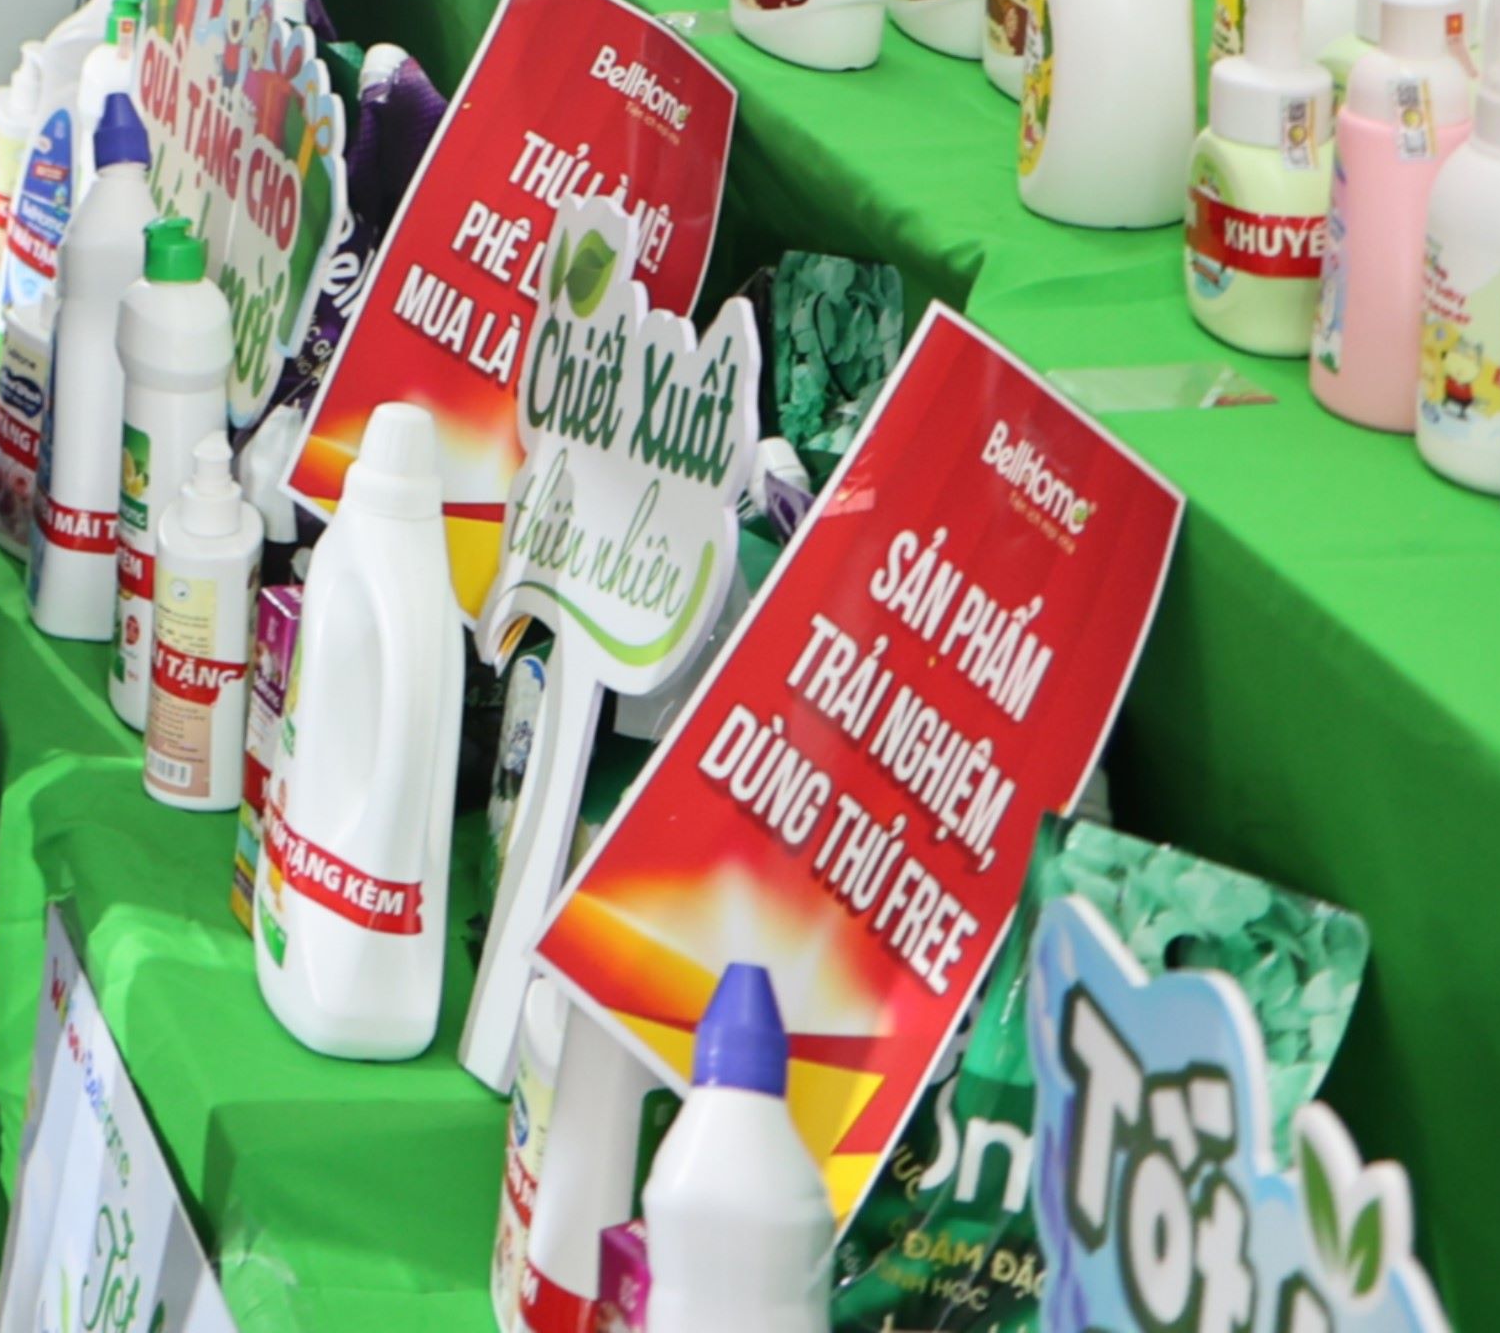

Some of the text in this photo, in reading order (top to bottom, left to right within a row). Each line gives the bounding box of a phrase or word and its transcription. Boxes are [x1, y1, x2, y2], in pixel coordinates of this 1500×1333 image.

[589, 44, 688, 131] BellHome
[246, 146, 299, 252] CHO
[508, 130, 591, 215] THỬ
[450, 200, 533, 284] PHÊ
[393, 262, 470, 355] MUA
[468, 301, 523, 385] LÀ
[525, 311, 739, 489] Chiết Xuất
[53, 509, 101, 540] MÃI
[506, 449, 686, 620] thiên nhiên
[980, 418, 1092, 535] BellHome
[872, 525, 1054, 724] SẢN PHẨM
[785, 613, 1020, 874] TRẢI NGHIỆM,
[342, 865, 408, 916] KÈM
[698, 703, 980, 997] DÙNG THỬ FREE
